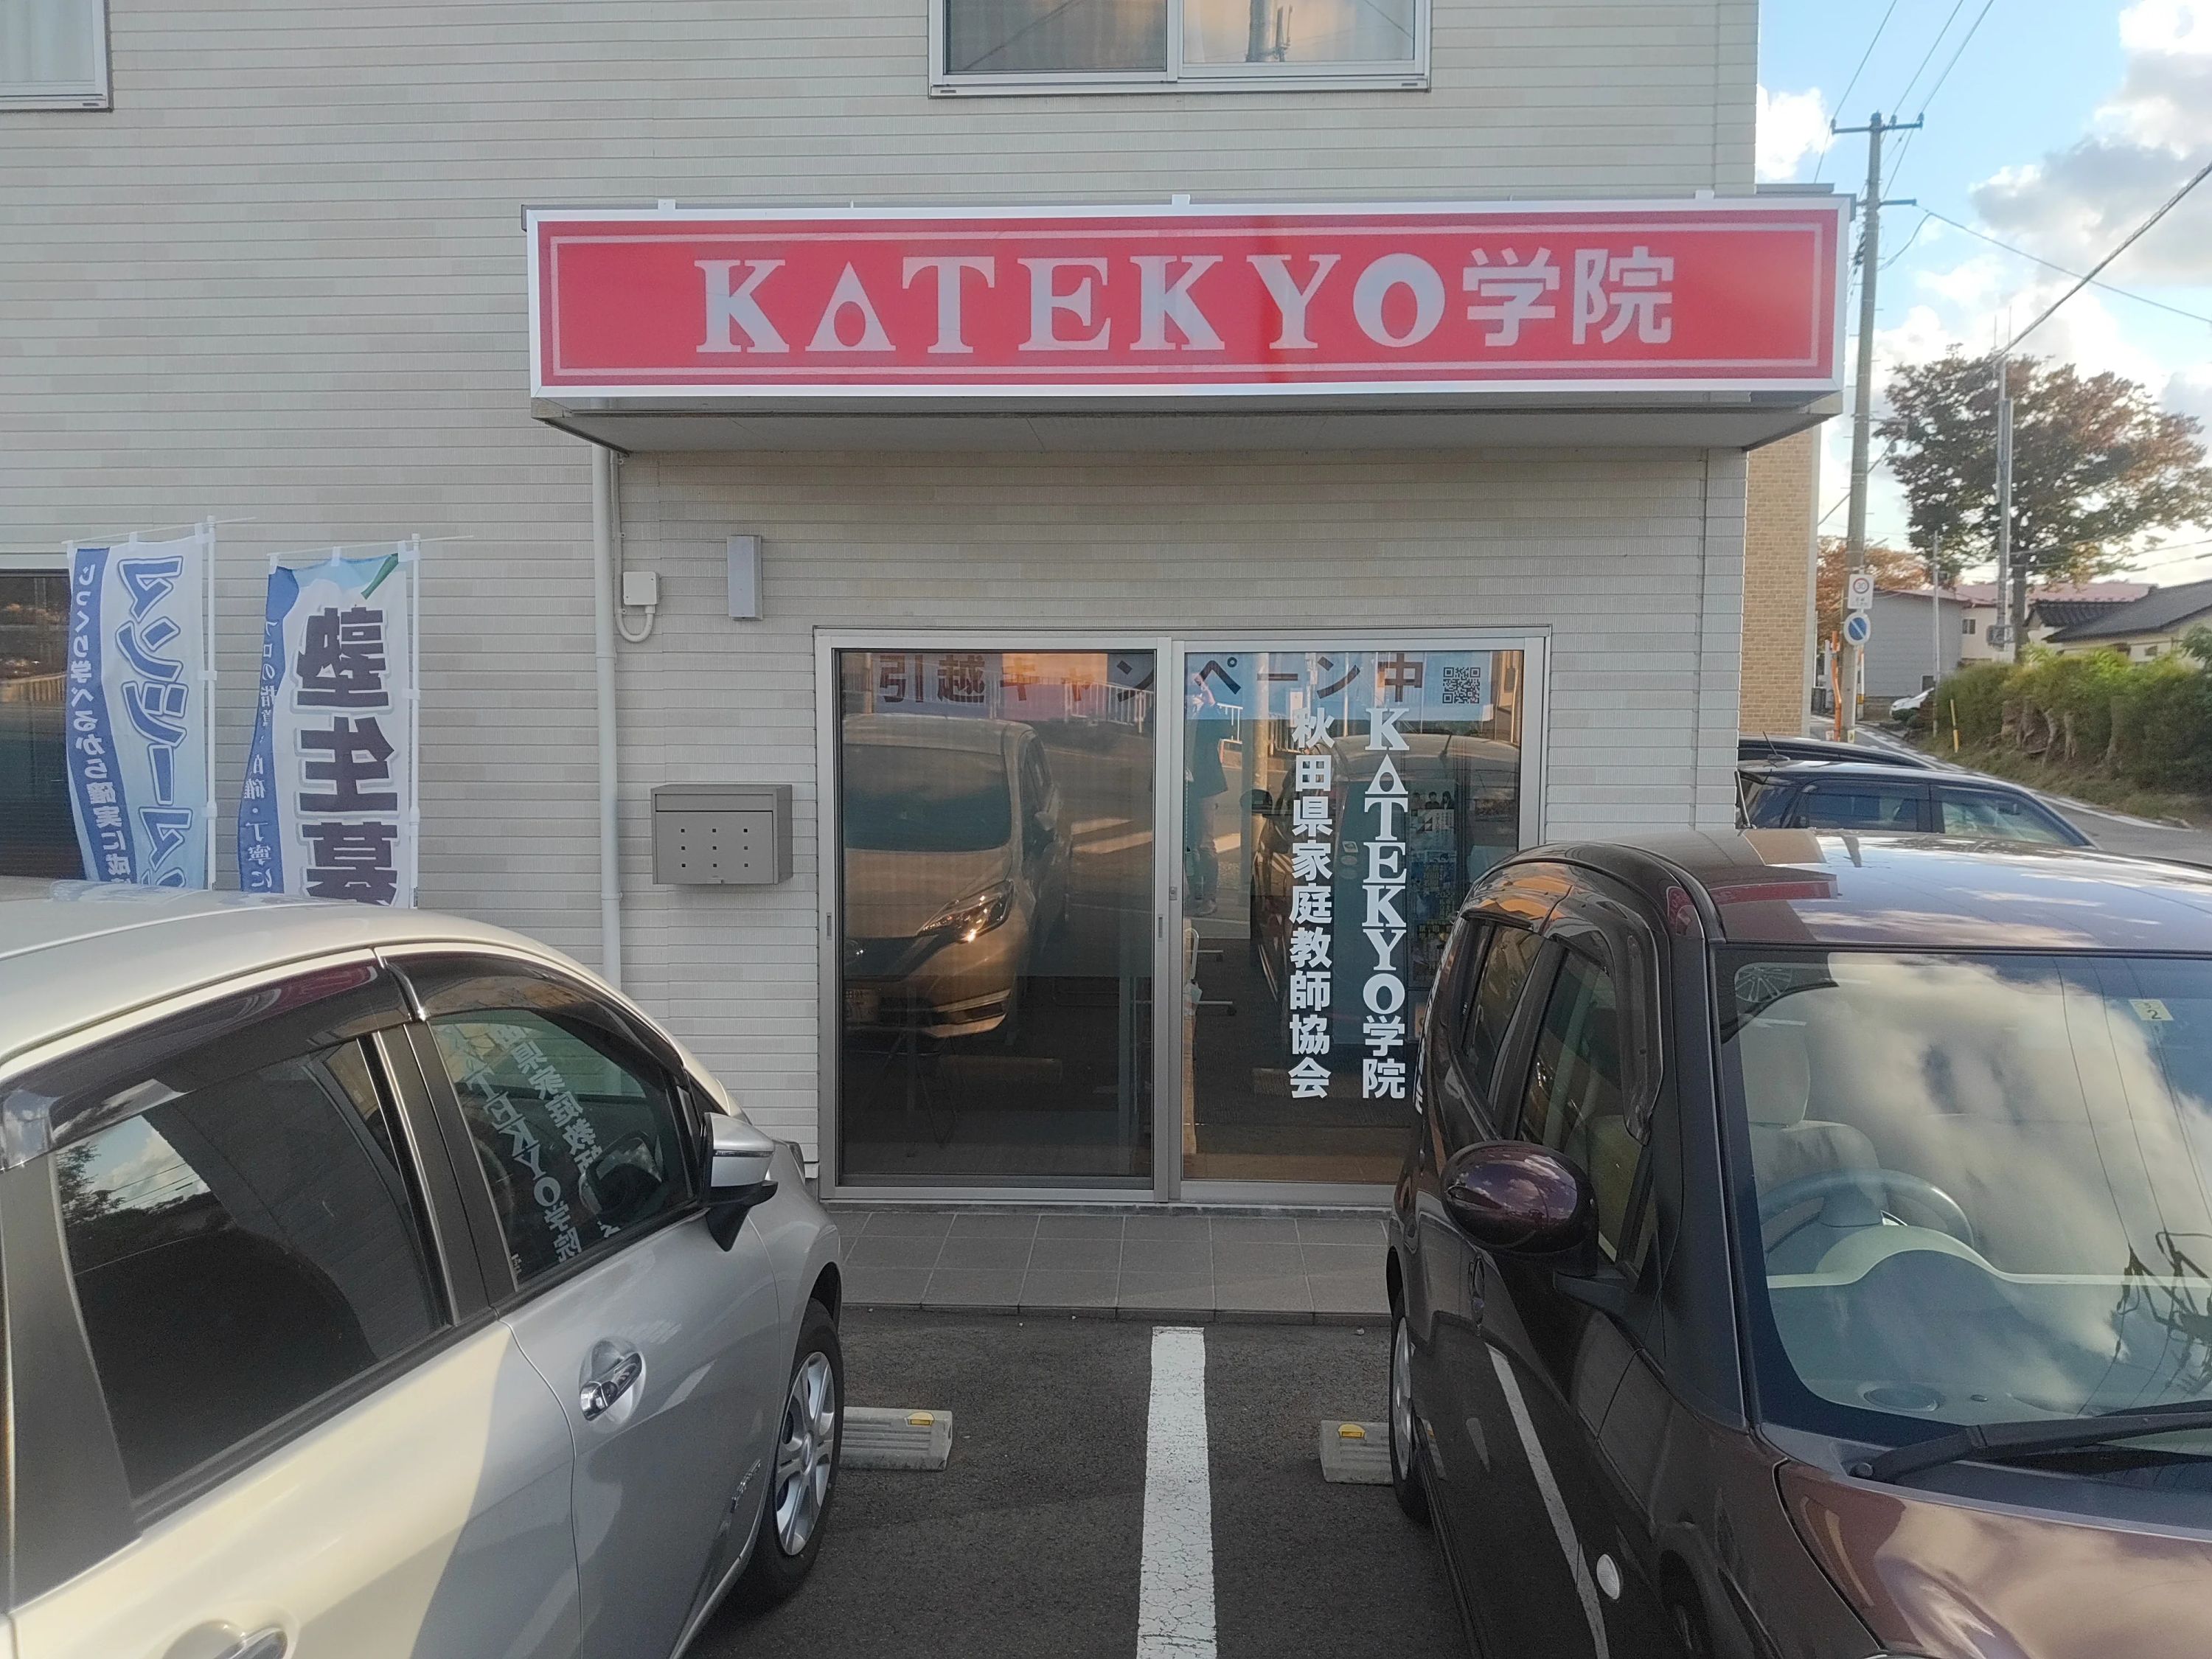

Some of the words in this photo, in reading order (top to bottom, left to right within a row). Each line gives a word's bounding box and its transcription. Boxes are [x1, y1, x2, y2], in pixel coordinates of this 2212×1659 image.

[694, 245, 1674, 355] KATEKYO学院
[1288, 707, 1336, 1099] 秋田県家庭教師協会
[1362, 707, 1411, 1099] KATEKYO学院
